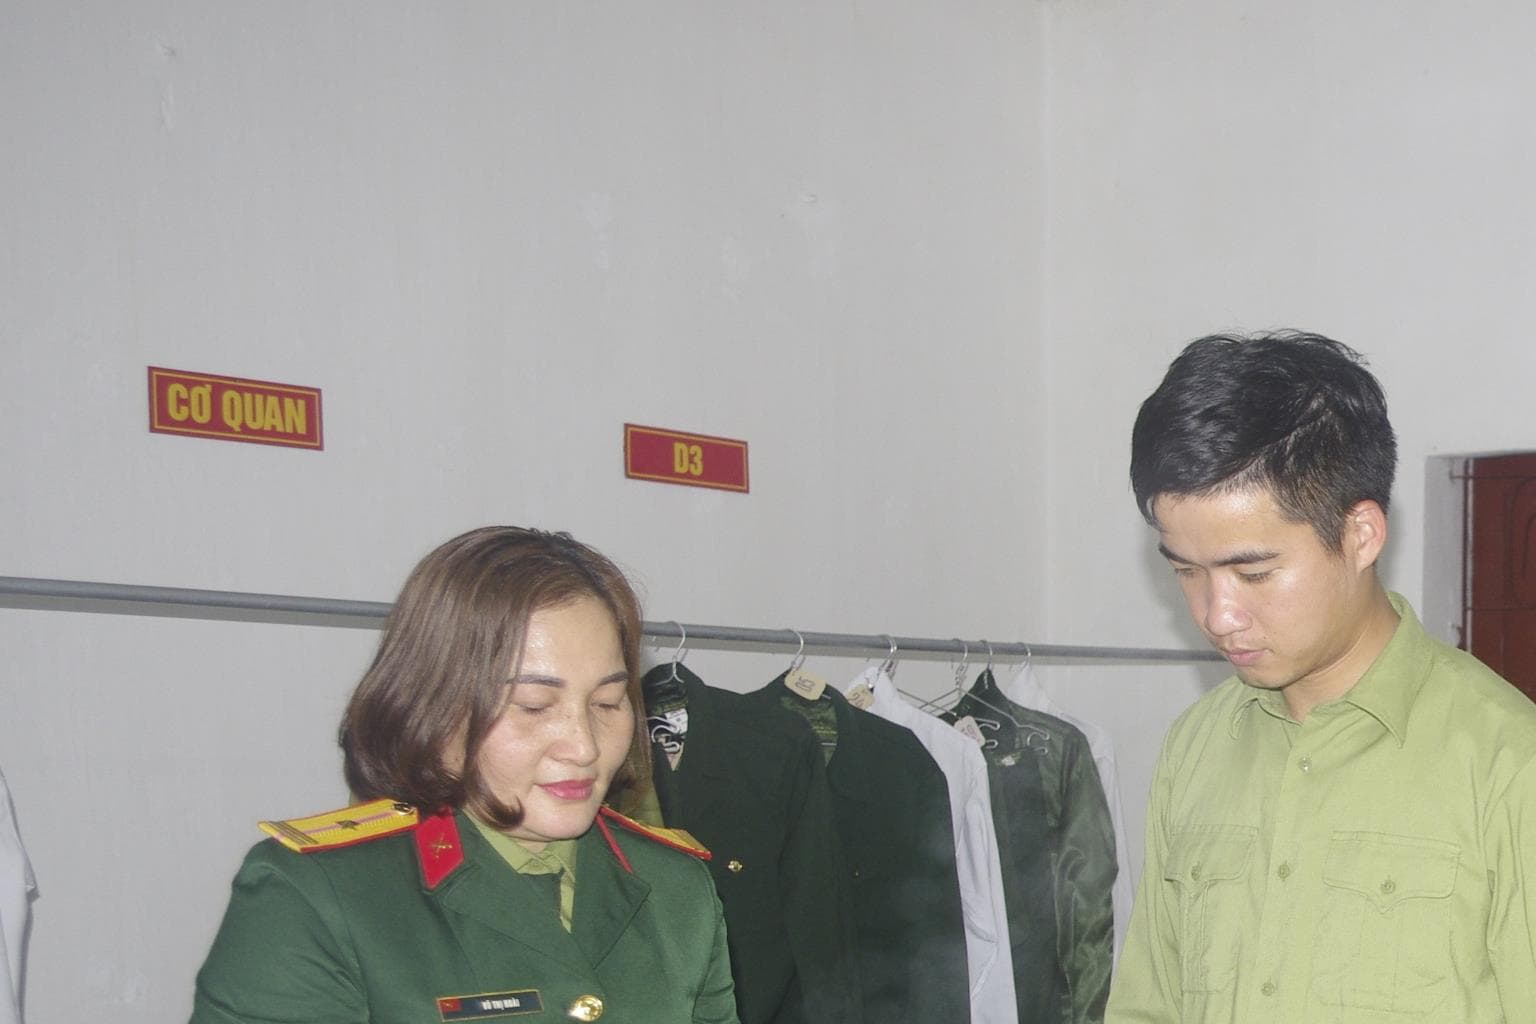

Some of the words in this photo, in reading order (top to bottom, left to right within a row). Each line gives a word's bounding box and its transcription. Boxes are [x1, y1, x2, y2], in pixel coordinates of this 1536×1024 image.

[168, 383, 212, 424] CƠ
[222, 390, 307, 434] QUAN
[674, 442, 703, 476] D3
